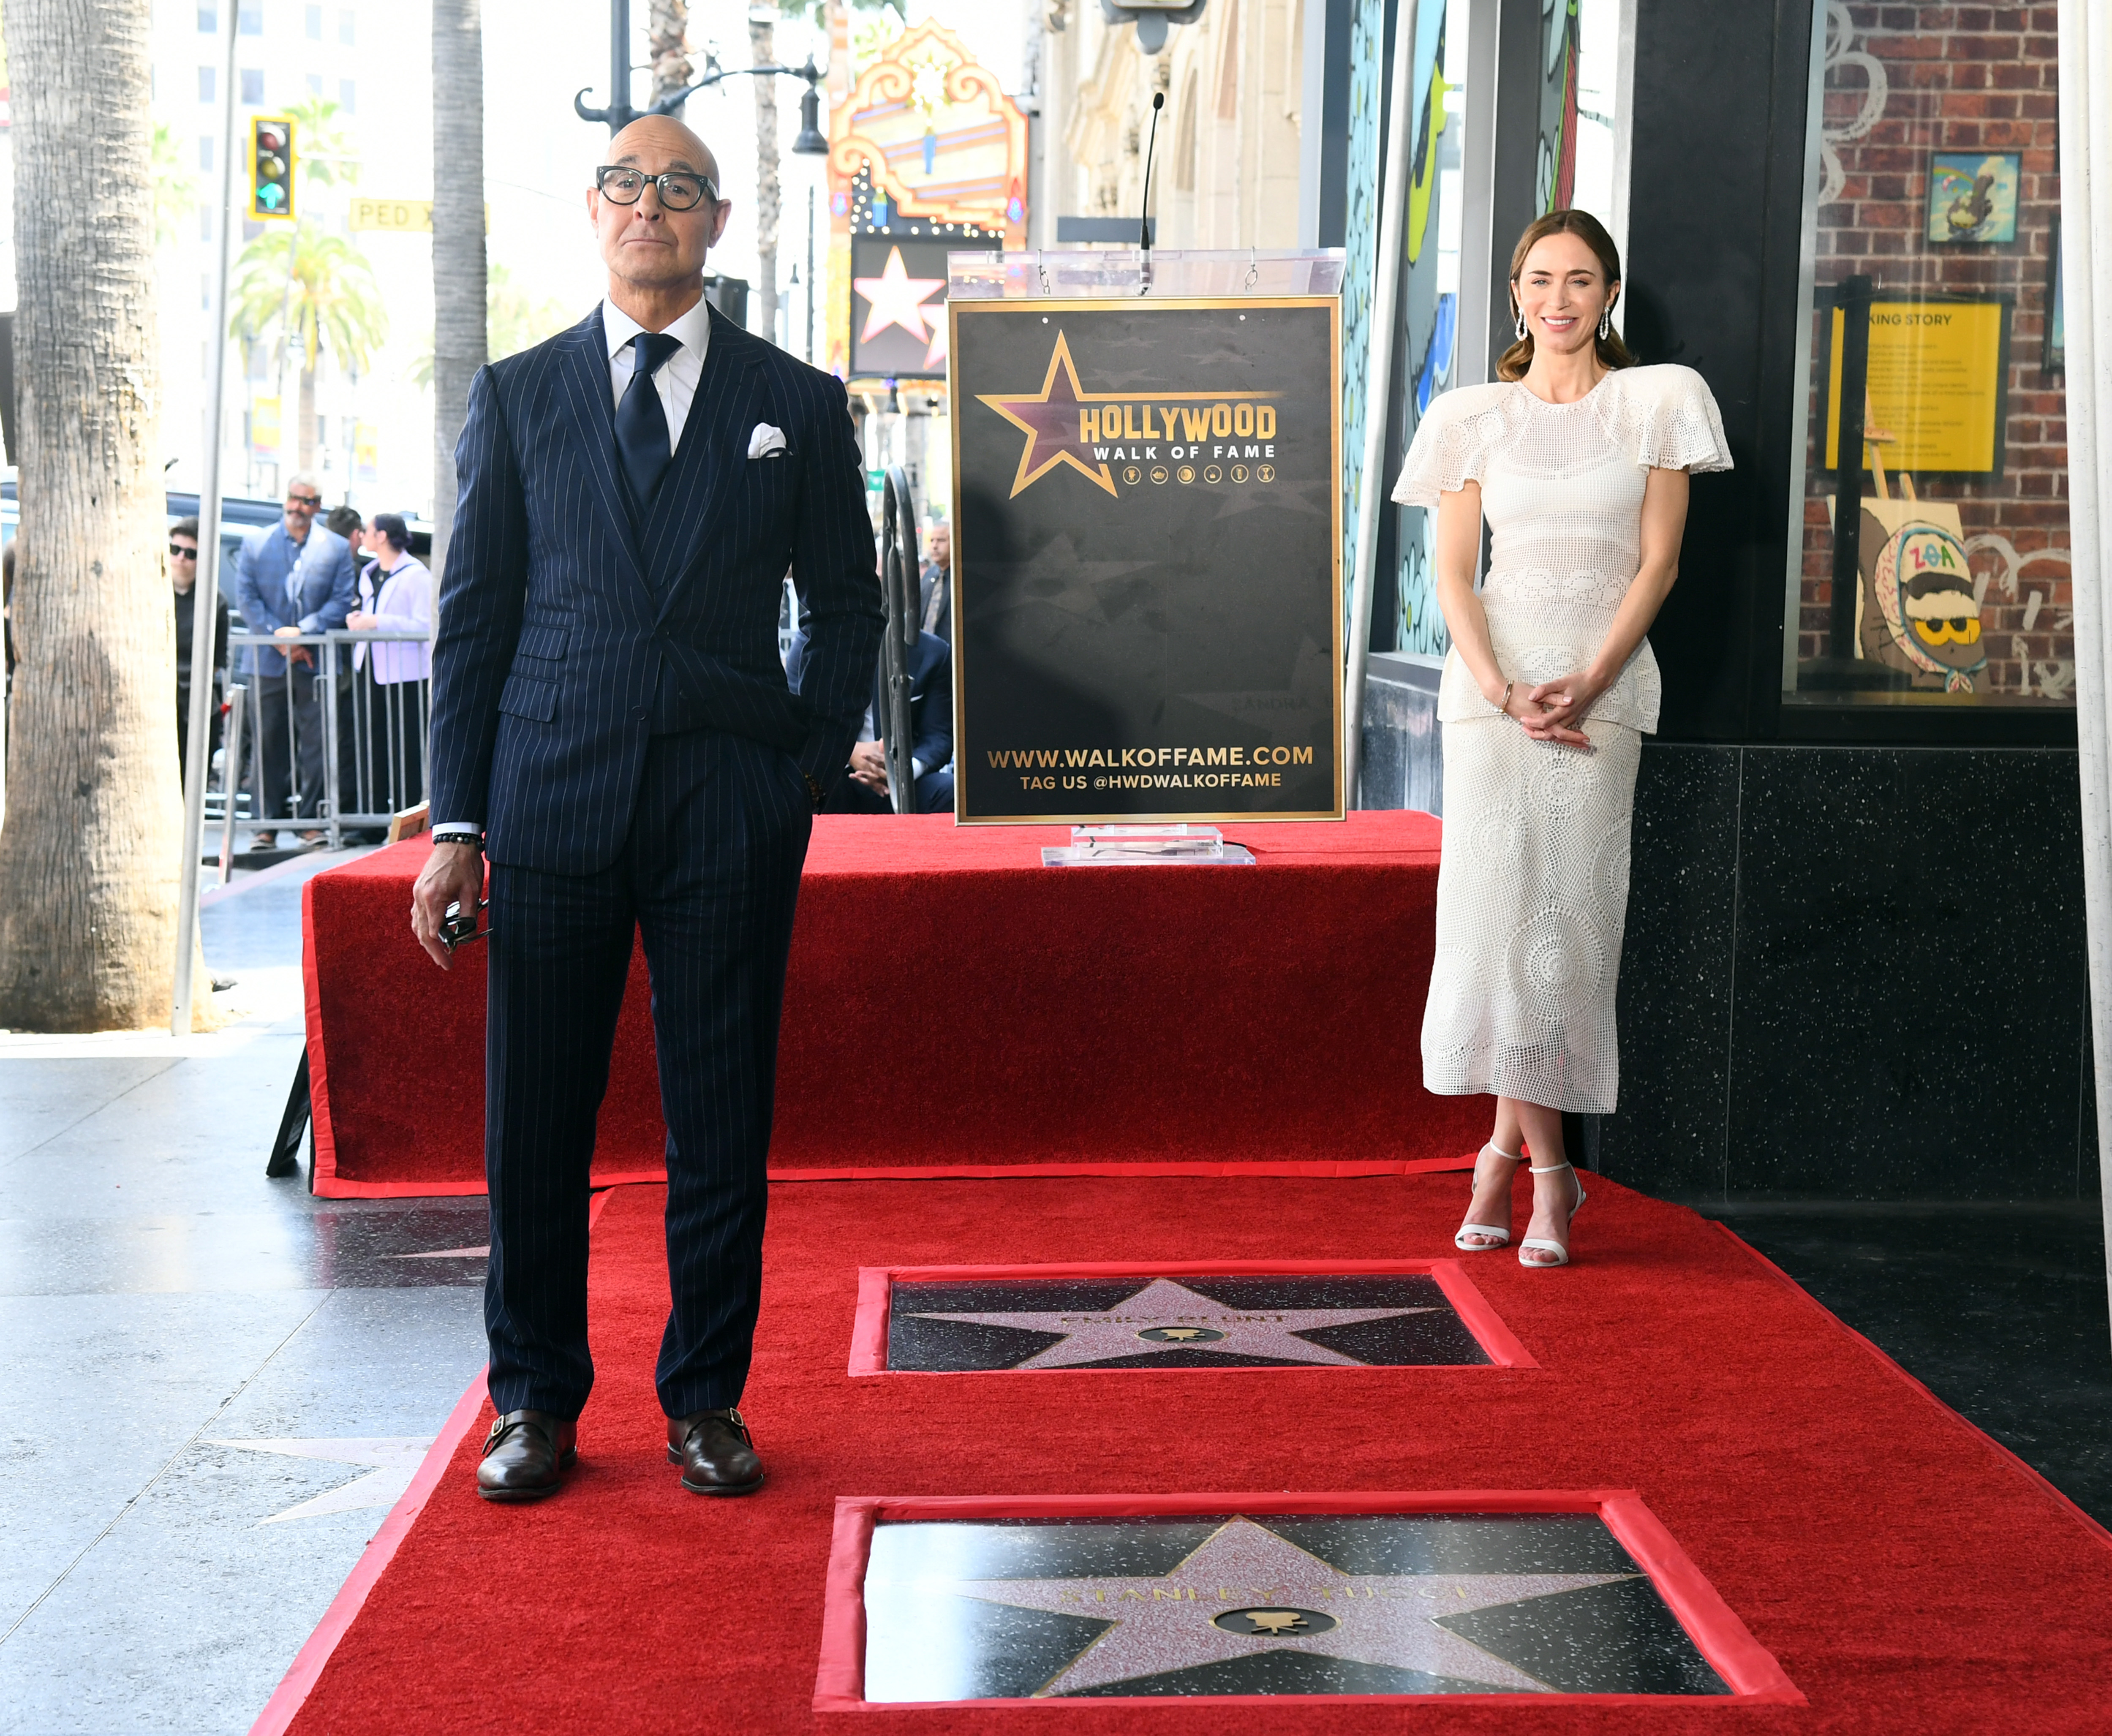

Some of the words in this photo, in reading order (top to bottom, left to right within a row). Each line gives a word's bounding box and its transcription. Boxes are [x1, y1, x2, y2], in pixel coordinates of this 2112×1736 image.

[360, 204, 408, 226] PED
[1905, 314, 1952, 326] STORY
[1080, 403, 1276, 443] HOLLYWOOD
[1093, 447, 1157, 460] WALK
[1171, 446, 1199, 459] OF
[1214, 445, 1275, 459] FAME
[987, 746, 1313, 768] WWW.WALKOFFAME.COM
[1020, 776, 1056, 789] TAG
[1063, 775, 1087, 789] US
[1094, 773, 1281, 790] @HWDWALKOFFAME
[1060, 1585, 1285, 1602] STANLEY
[1310, 1586, 1467, 1600] TUCCI
